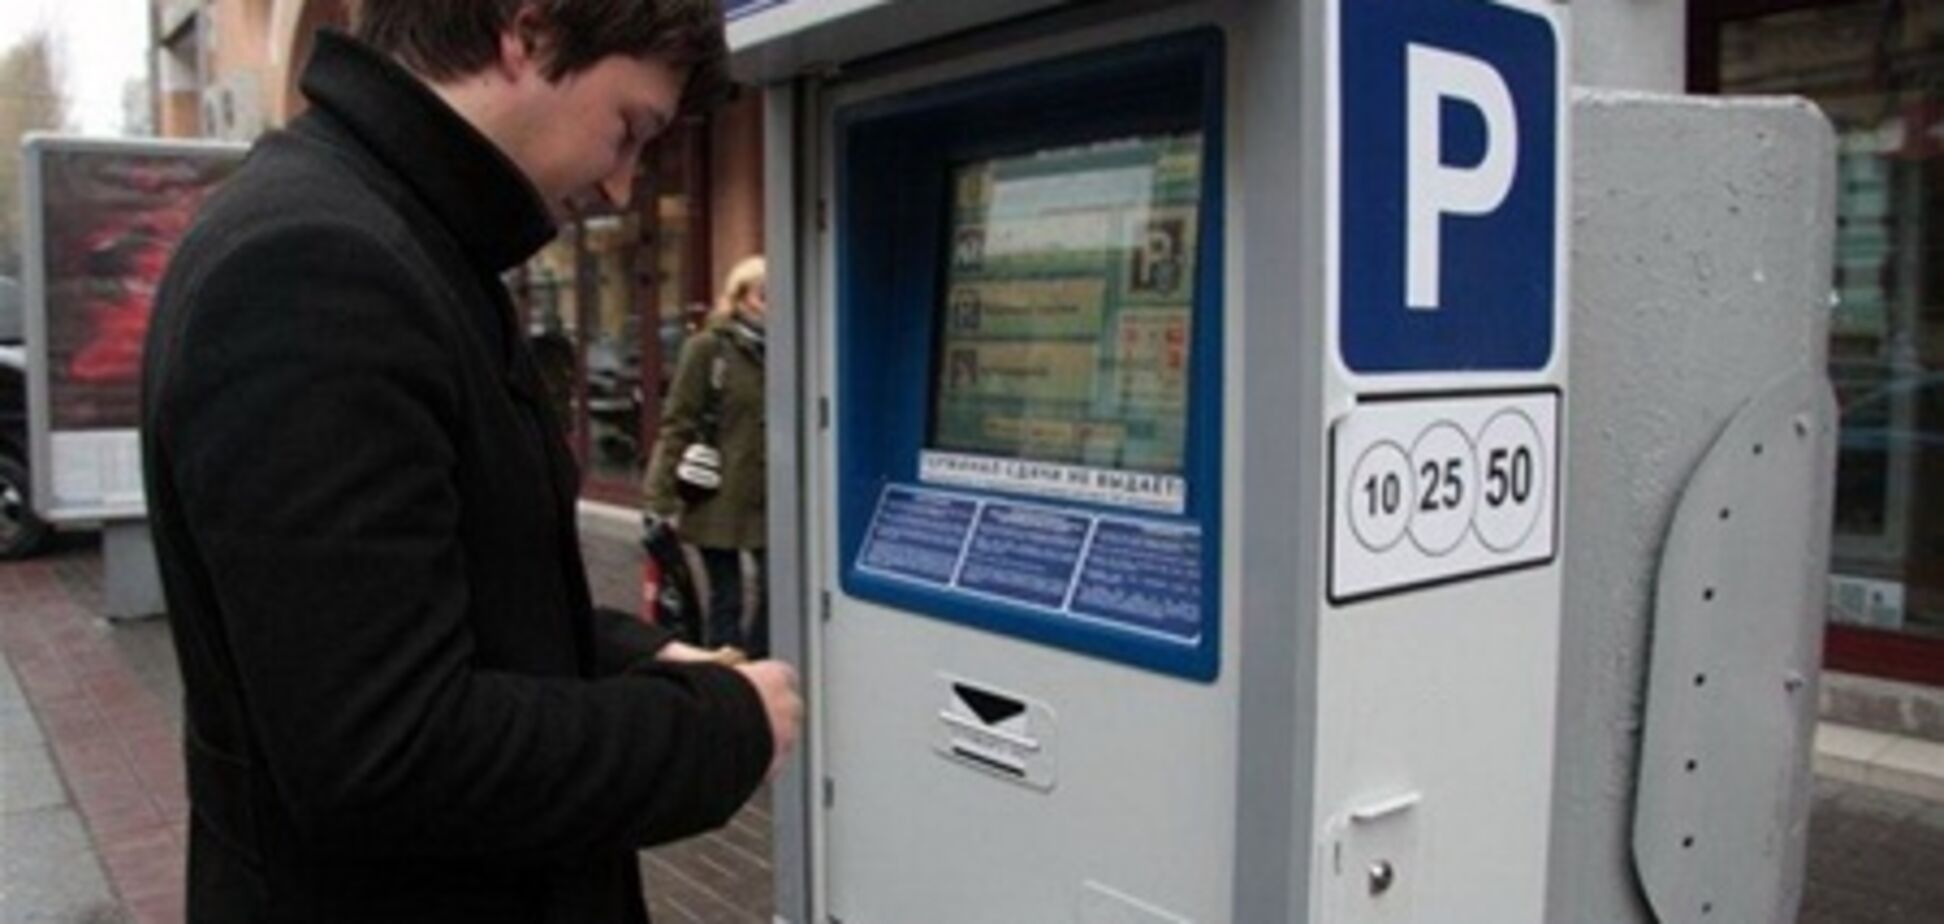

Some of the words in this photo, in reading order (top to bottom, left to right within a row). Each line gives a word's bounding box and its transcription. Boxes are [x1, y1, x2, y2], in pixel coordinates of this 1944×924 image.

[1407, 42, 1518, 309] P
[1364, 472, 1400, 516] 10
[1420, 458, 1463, 511] 25
[1486, 445, 1531, 507] 50
